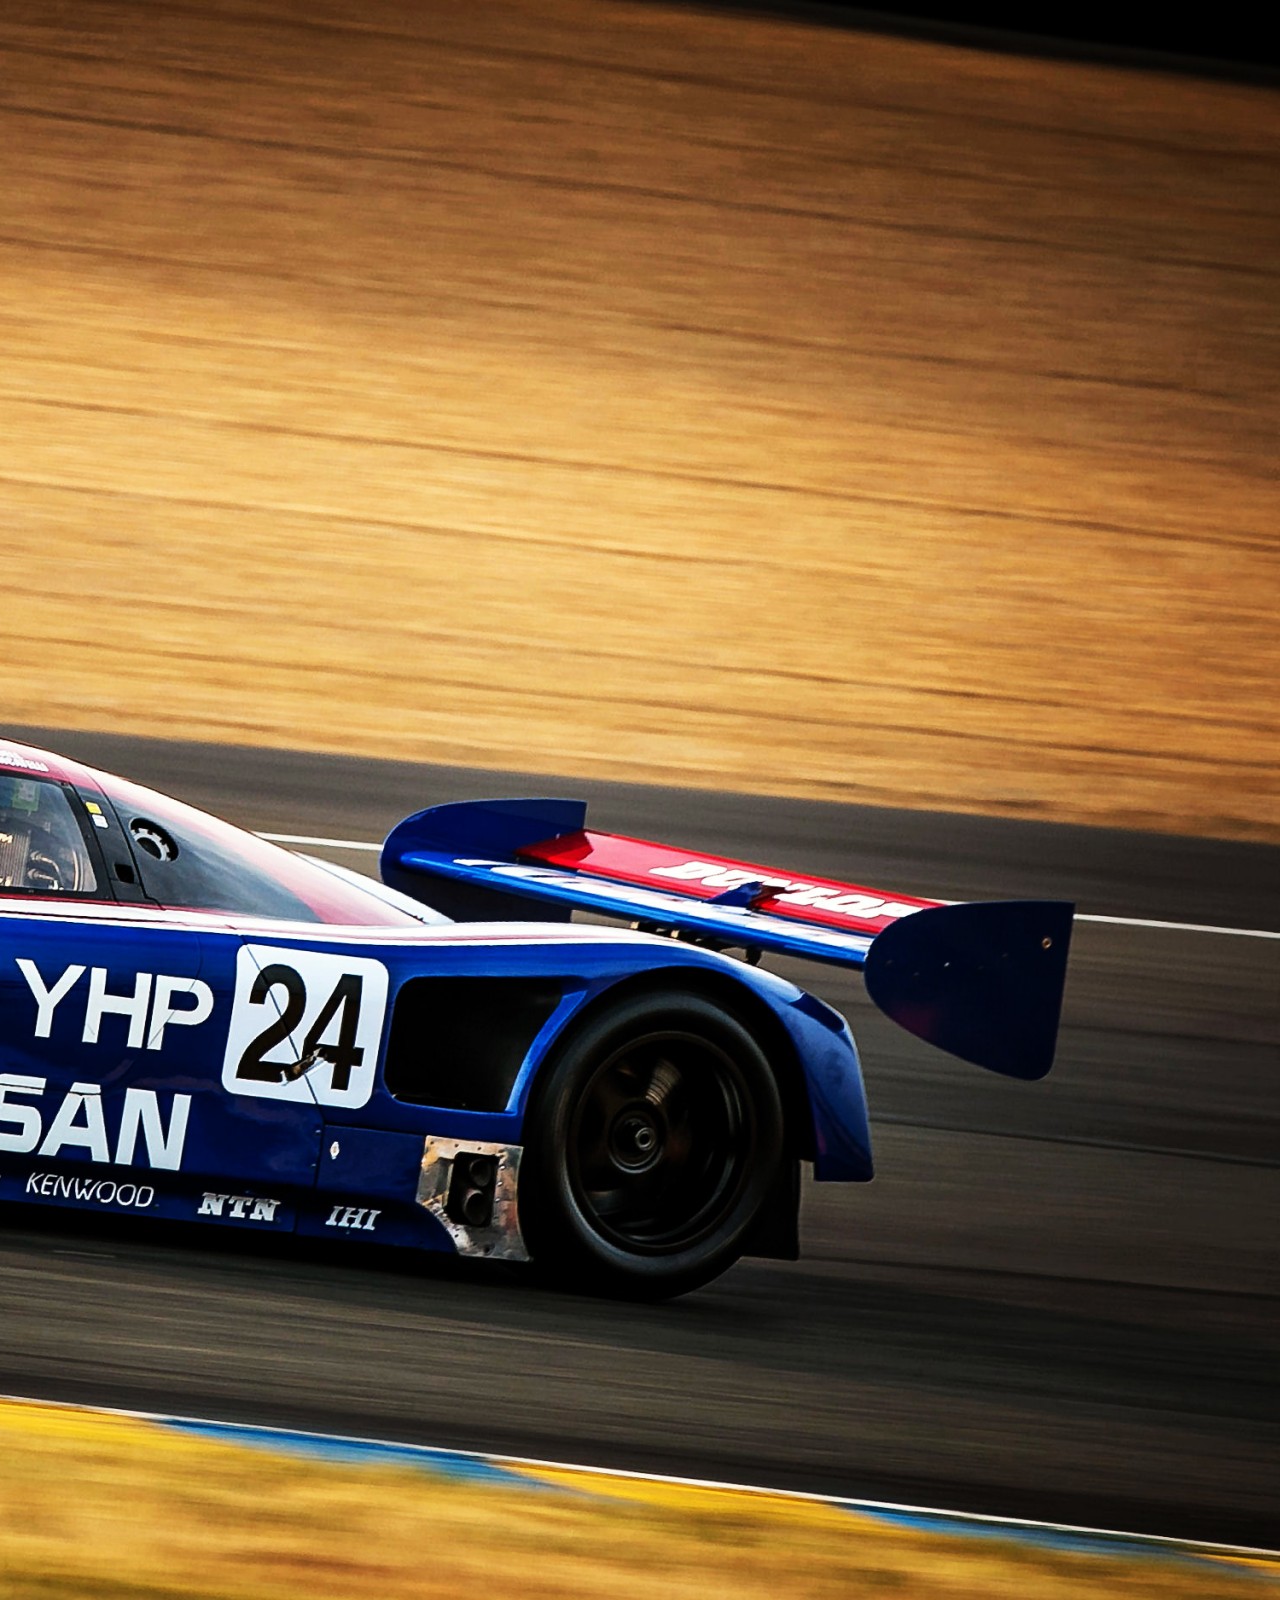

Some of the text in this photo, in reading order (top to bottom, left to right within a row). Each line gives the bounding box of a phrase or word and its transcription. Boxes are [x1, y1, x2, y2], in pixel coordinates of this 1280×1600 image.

[15, 957, 214, 1051] YHP
[235, 963, 365, 1091] 24
[26, 1172, 155, 1208] KENWOOD
[197, 1191, 282, 1222] NTN
[325, 1205, 382, 1231] IHI
